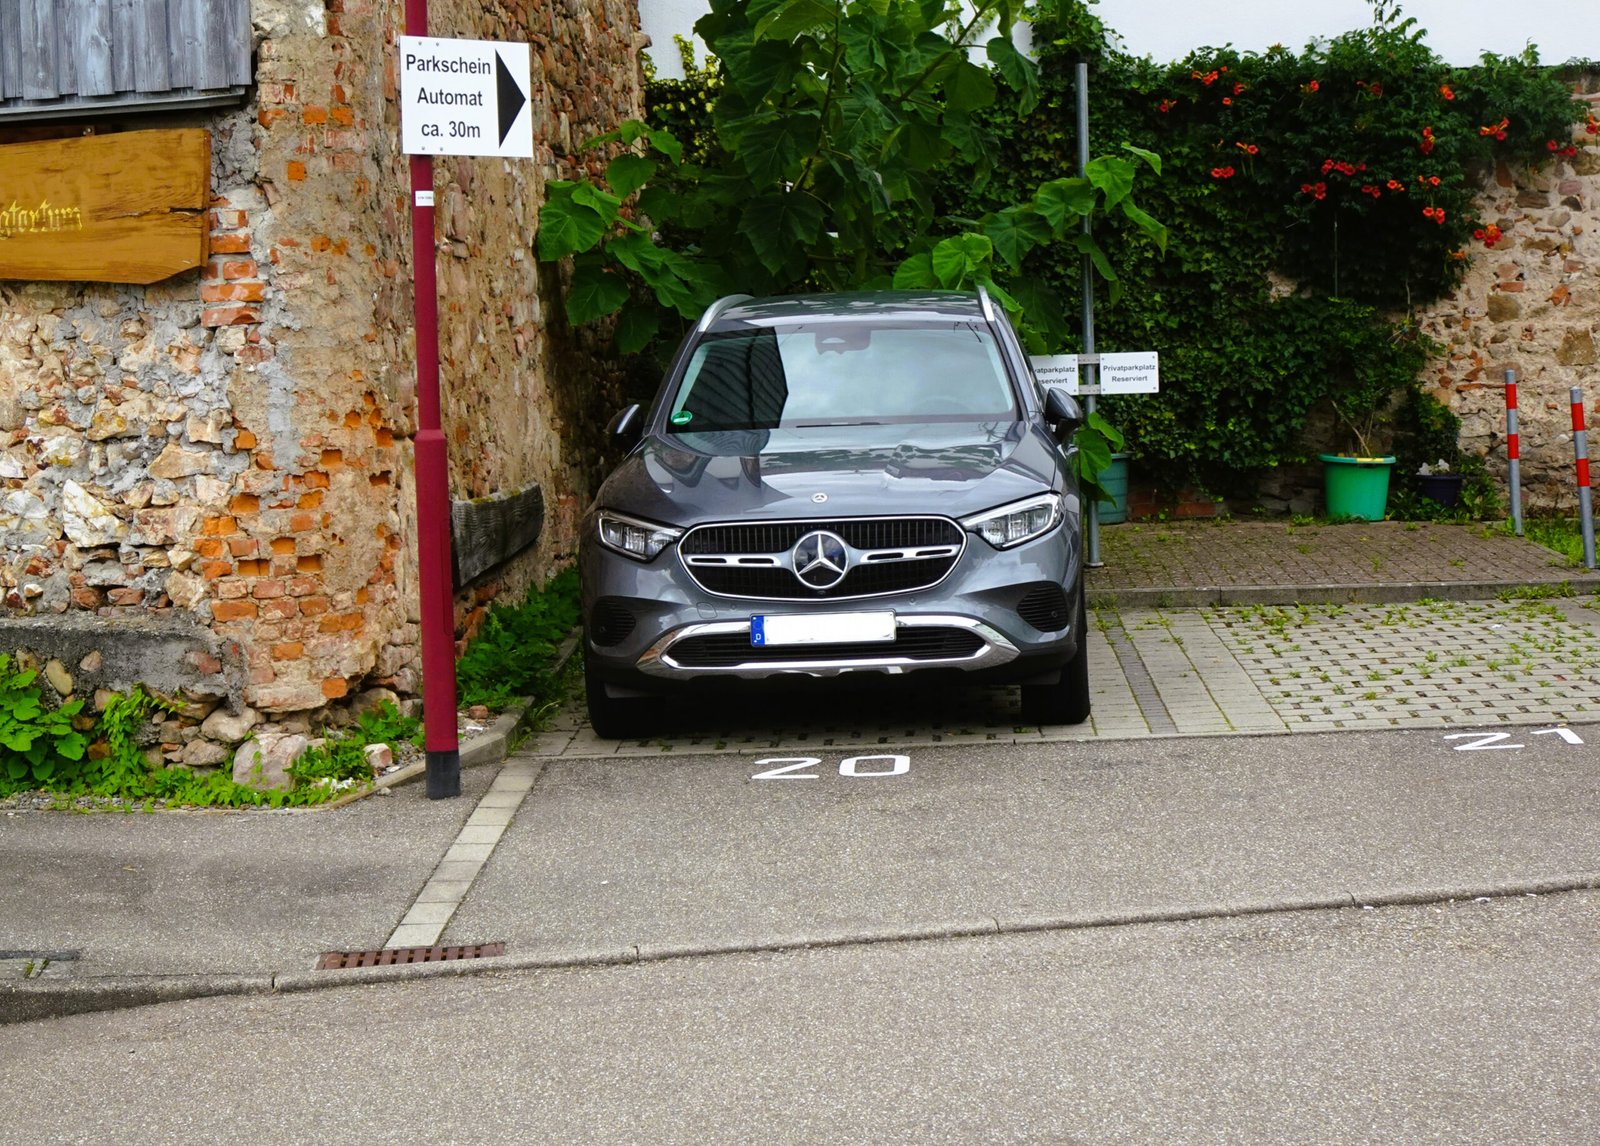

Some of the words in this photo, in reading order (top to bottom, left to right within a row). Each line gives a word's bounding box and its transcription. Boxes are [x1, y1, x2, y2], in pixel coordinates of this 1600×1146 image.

[405, 53, 491, 75] Parkschein
[417, 87, 483, 106] Automat
[421, 124, 444, 137] ca.
[449, 121, 481, 138] 30m
[1103, 364, 1156, 373] Privatparkplatz
[1111, 375, 1148, 383] Reserviert
[755, 633, 762, 641] D
[1443, 728, 1585, 751] 21
[751, 755, 911, 780] 20
